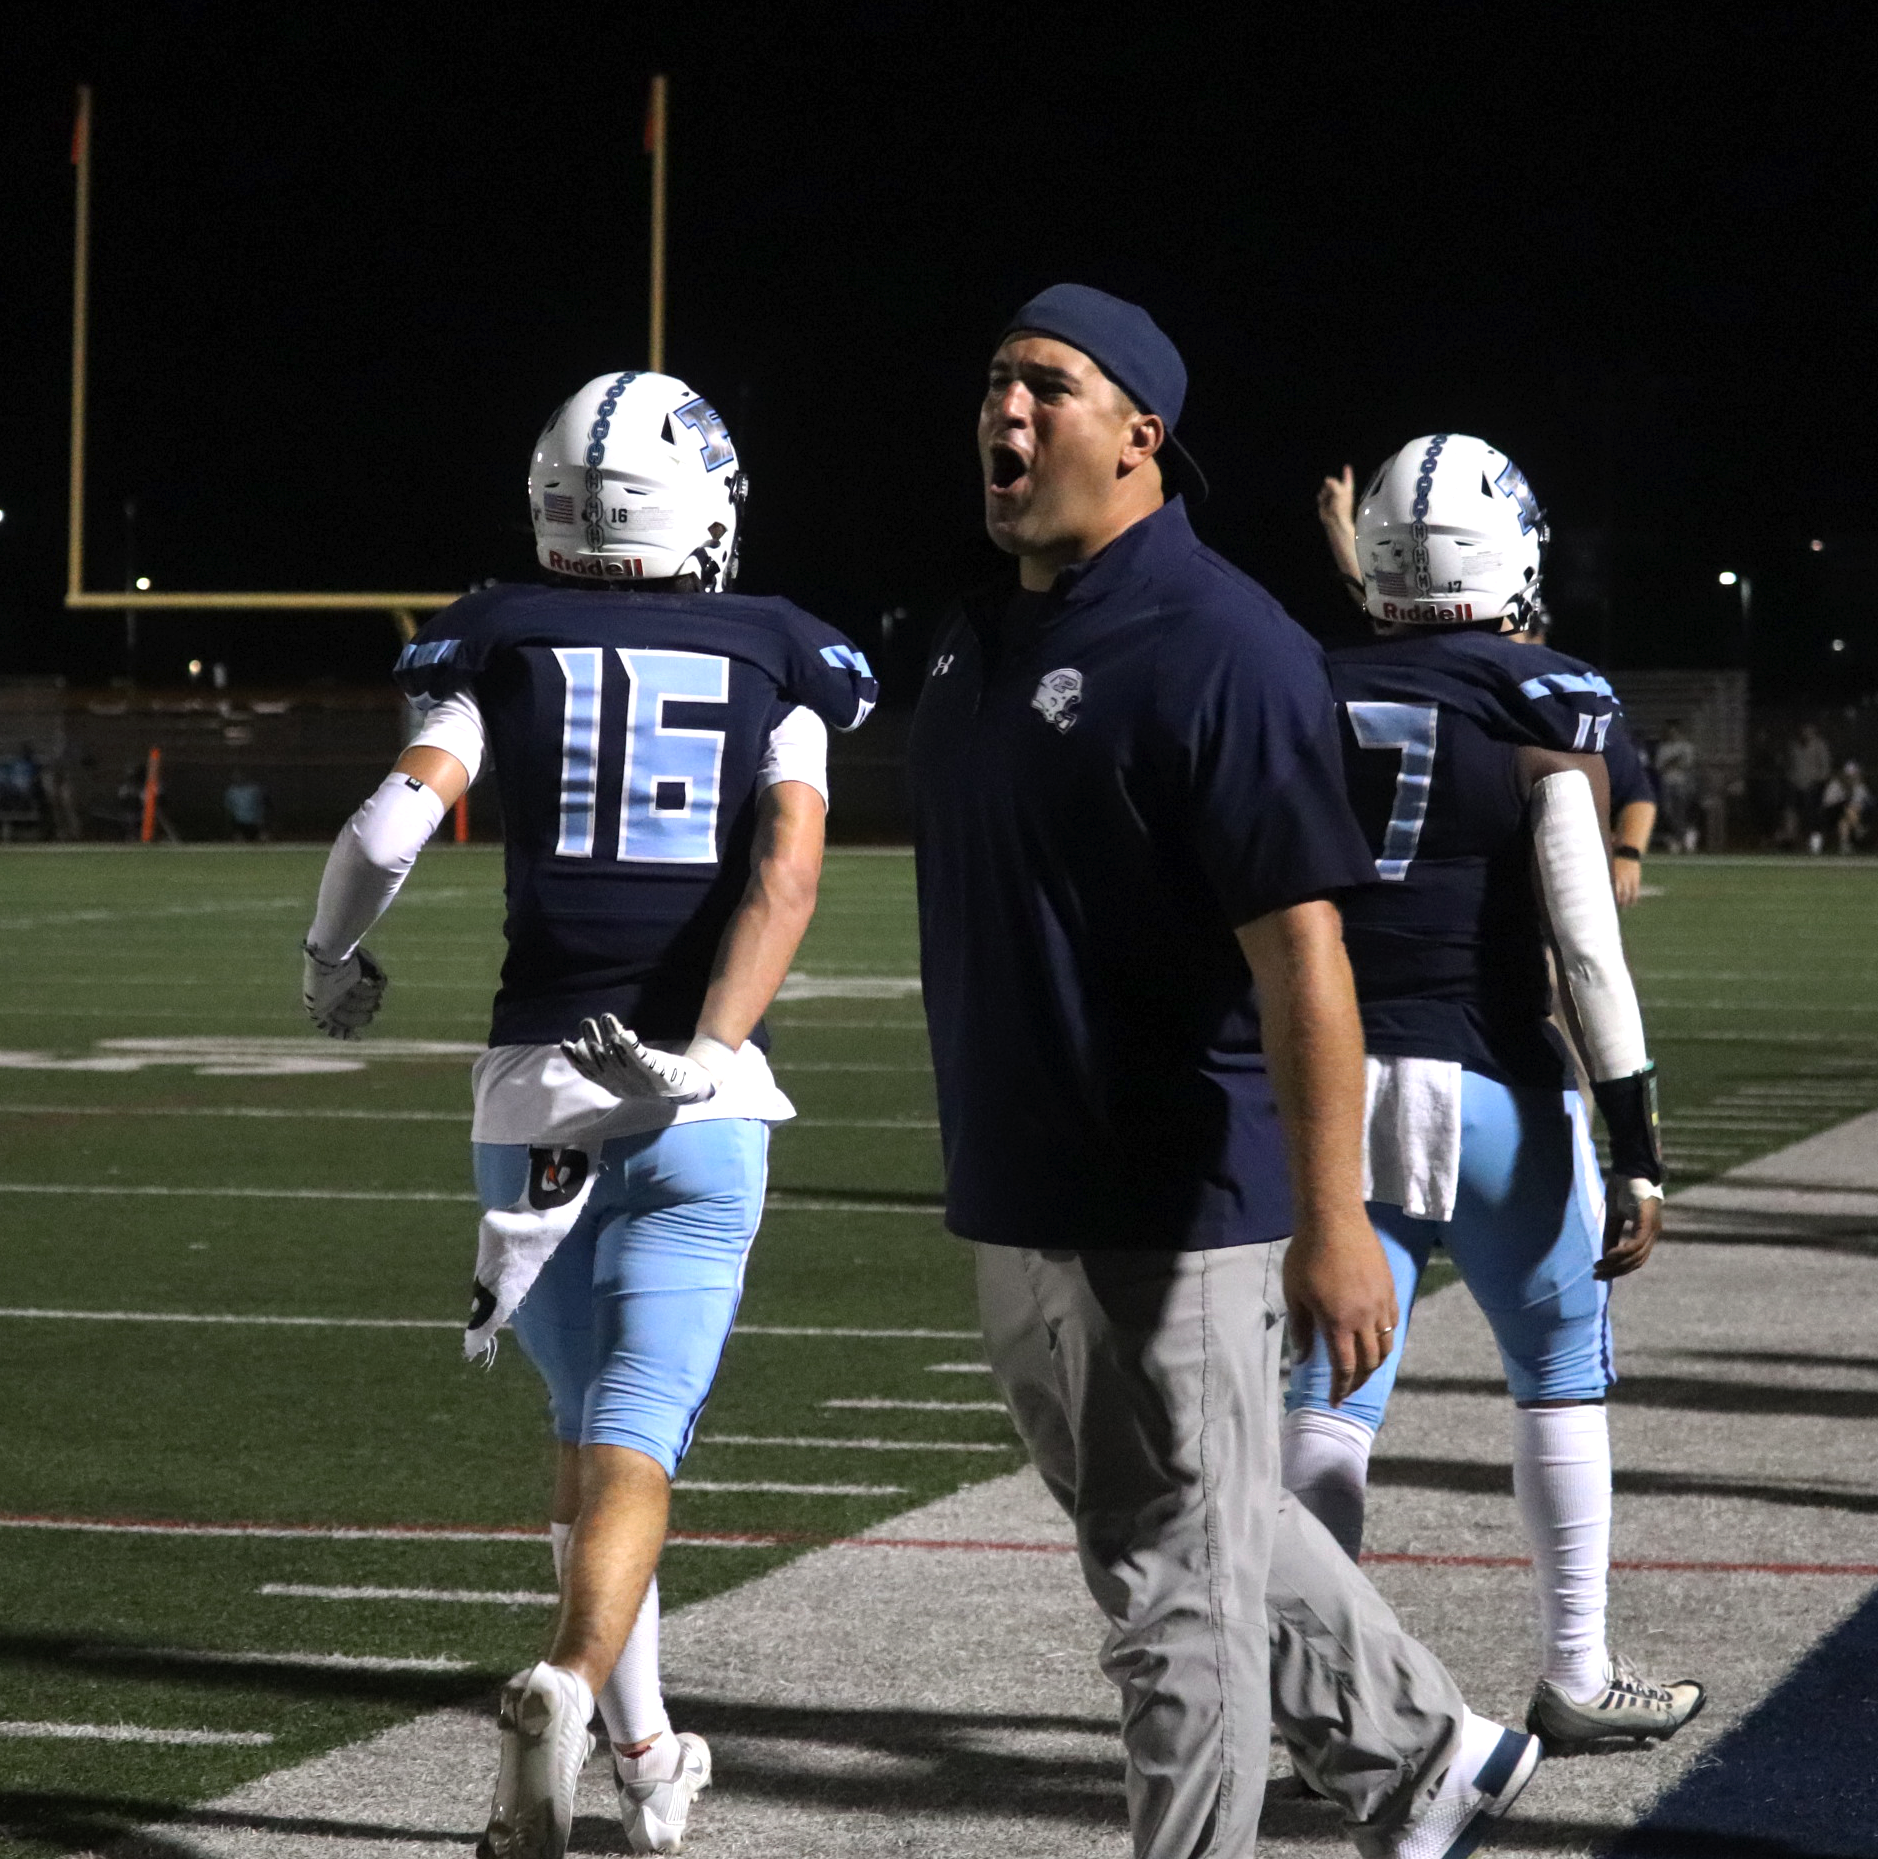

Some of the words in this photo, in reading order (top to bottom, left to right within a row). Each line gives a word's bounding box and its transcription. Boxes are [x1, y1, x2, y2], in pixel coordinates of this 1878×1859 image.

[610, 507, 628, 524] 16
[549, 550, 644, 578] Riddell
[1447, 580, 1462, 594] 17
[1383, 602, 1473, 622] Riddell
[1572, 711, 1613, 753] 17
[551, 647, 730, 863] 16
[1334, 701, 1438, 881] 7
